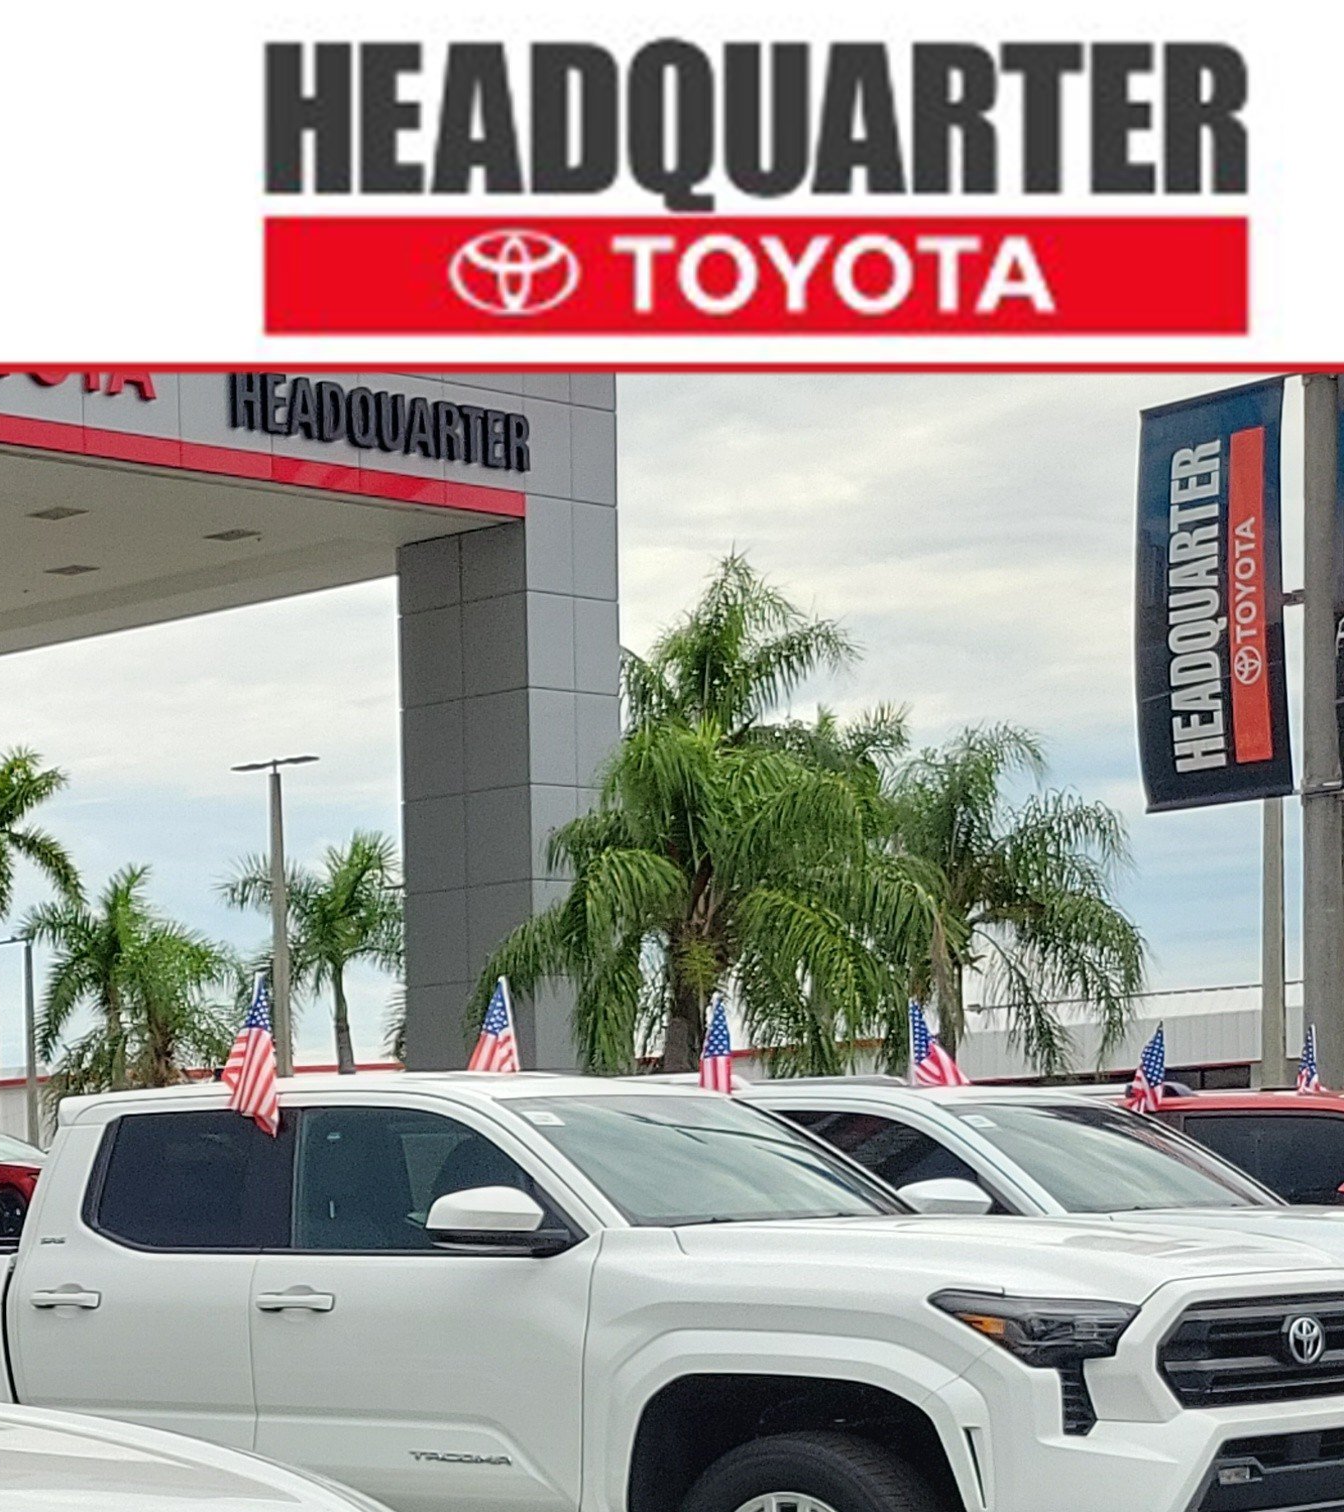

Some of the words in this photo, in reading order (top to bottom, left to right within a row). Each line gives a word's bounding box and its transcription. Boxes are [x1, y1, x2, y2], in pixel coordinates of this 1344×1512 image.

[229, 372, 531, 471] HEADQUARTER
[1167, 436, 1228, 773] HEADQUARTER
[1234, 517, 1256, 645] TOYOTA
[409, 1450, 512, 1466] TACOMA
